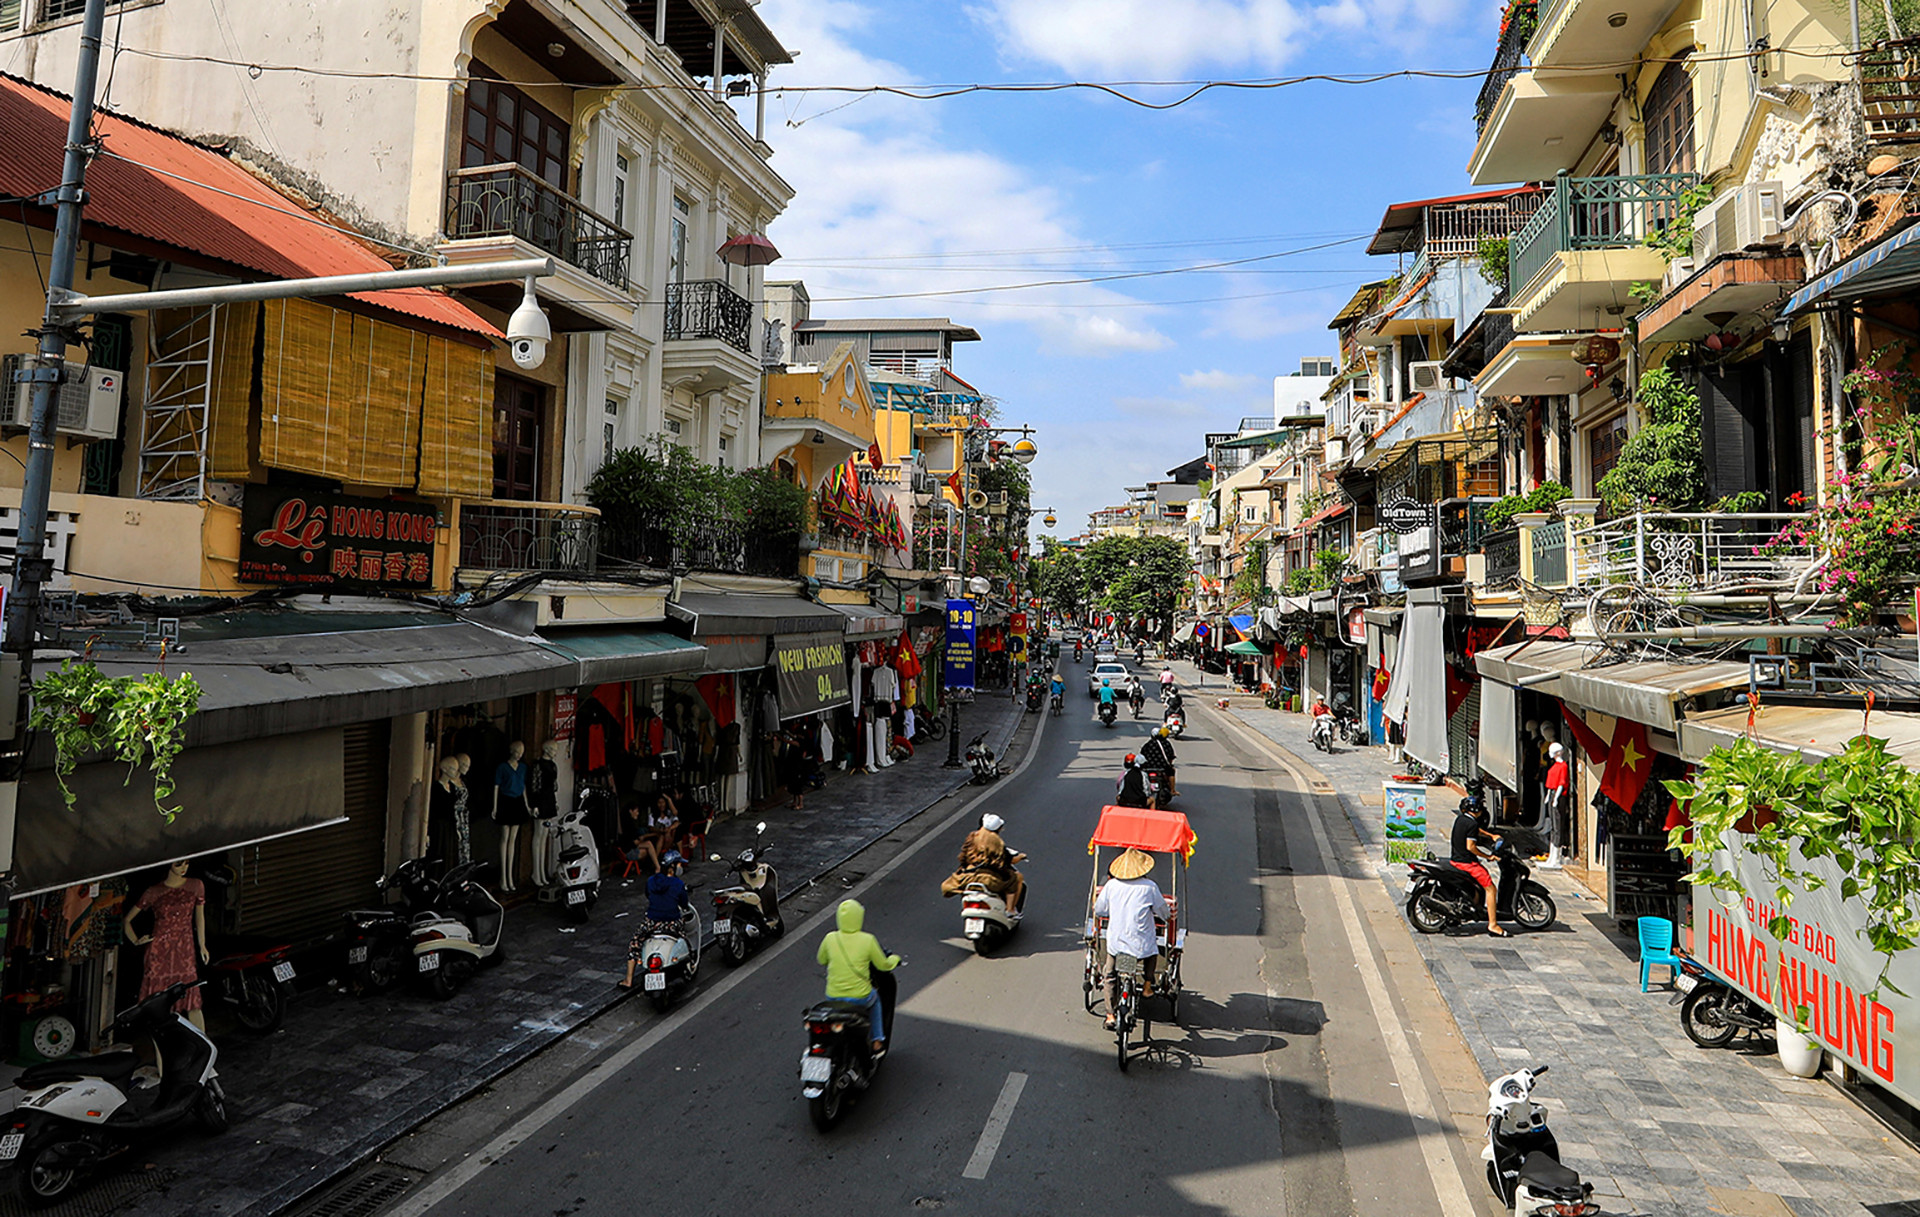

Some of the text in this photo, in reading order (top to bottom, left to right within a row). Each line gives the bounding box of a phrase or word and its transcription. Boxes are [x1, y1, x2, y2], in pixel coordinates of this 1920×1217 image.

[332, 505, 435, 545] HONG KONG
[1382, 508, 1427, 518] OldTown
[331, 547, 431, 583] 映丽香港
[805, 643, 843, 669] FASHION
[818, 674, 832, 702] 94
[1744, 896, 1837, 965] 9 HÀG ĐÀO
[1779, 950, 1894, 1083] NHUNG
